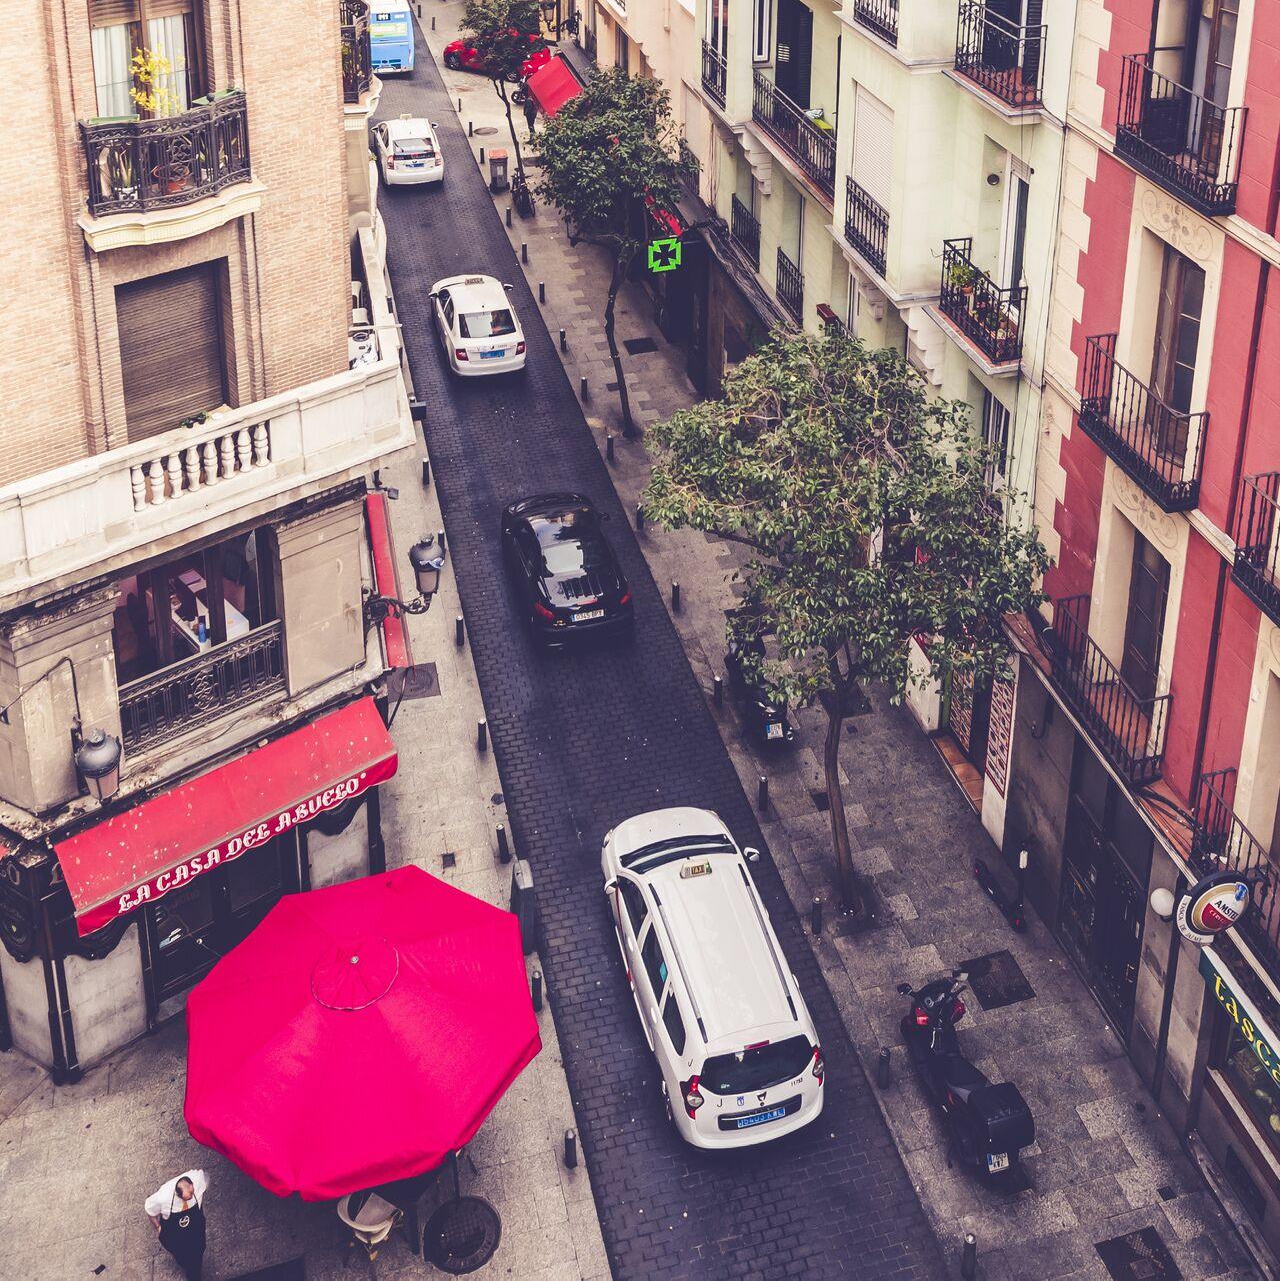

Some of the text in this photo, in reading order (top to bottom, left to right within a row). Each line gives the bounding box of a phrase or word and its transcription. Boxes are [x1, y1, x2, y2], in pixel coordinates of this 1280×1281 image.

[118, 884, 151, 914] LA
[156, 849, 222, 892] CASA
[225, 824, 271, 859] DEL
[274, 778, 360, 832] ABUELO
